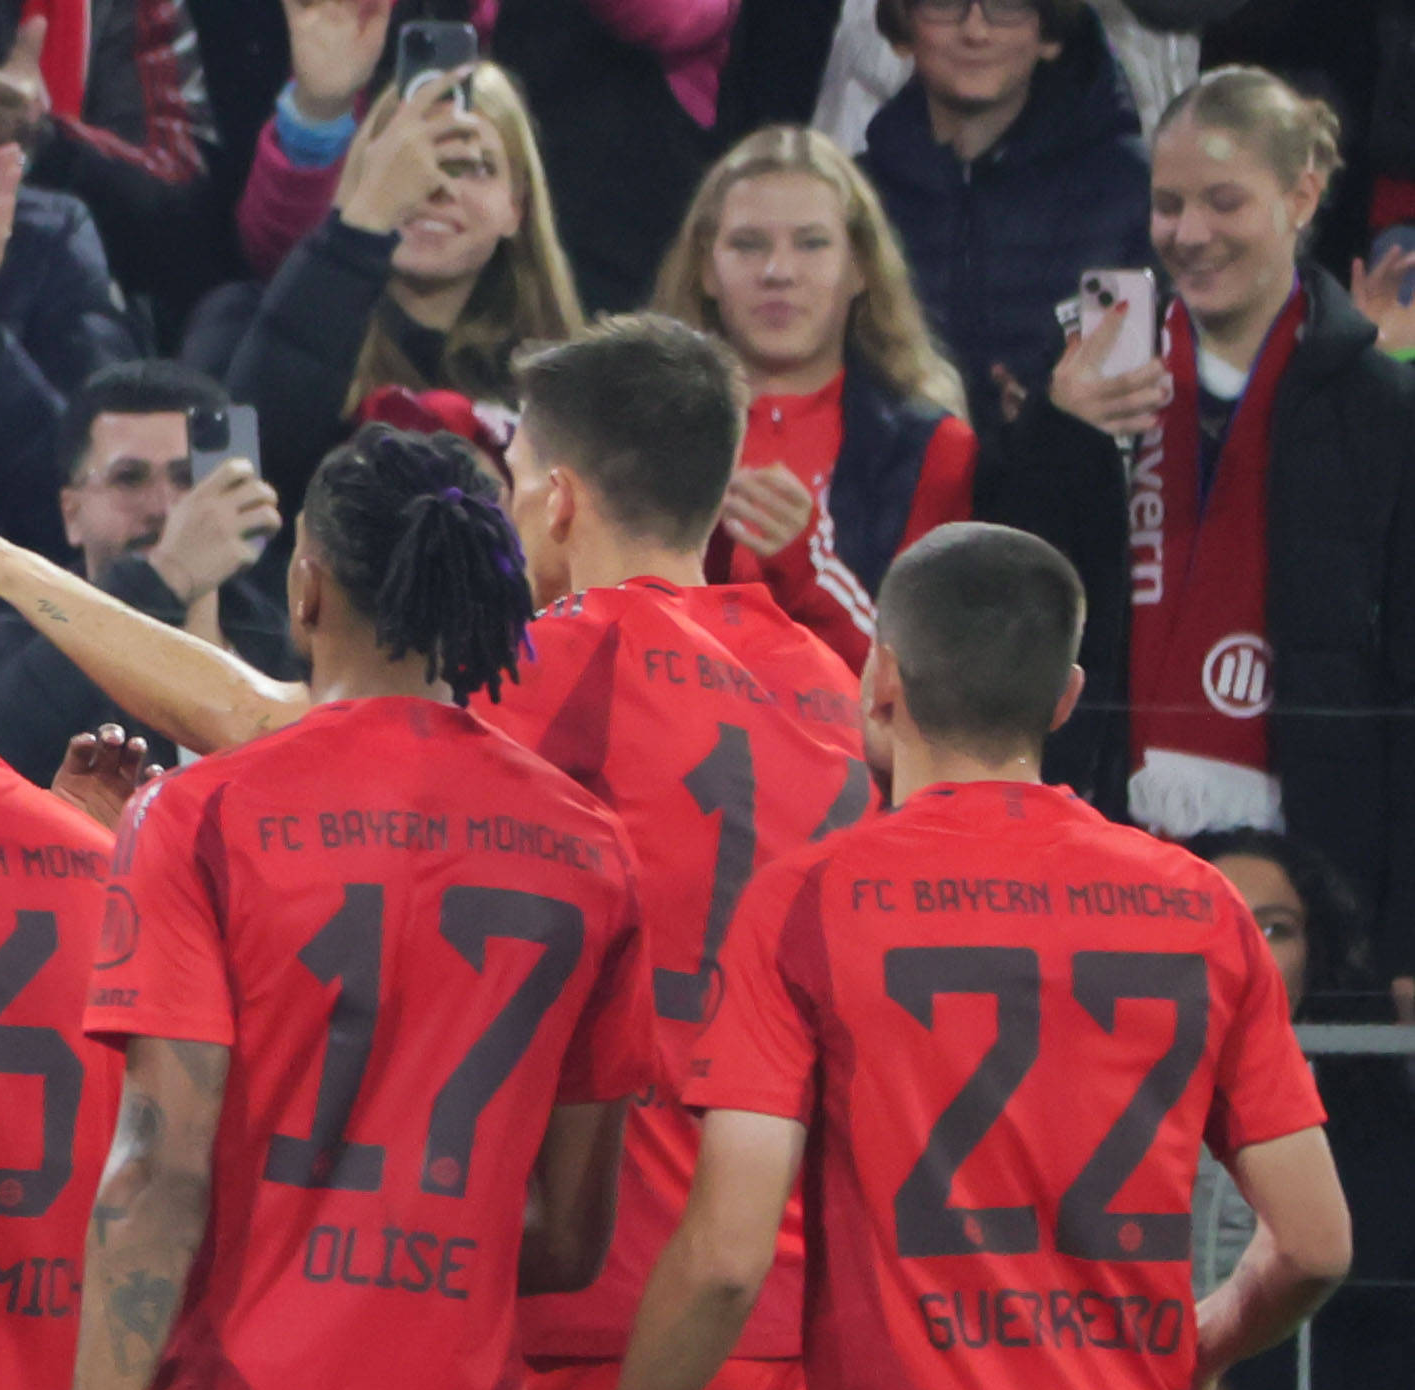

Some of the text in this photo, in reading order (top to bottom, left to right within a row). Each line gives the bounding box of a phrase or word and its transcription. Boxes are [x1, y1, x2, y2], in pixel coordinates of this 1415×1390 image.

[645, 650, 686, 684] FC
[258, 815, 304, 850] FC
[319, 810, 448, 850] BAYERN
[852, 879, 896, 912] FC
[912, 879, 1053, 914] BAYERN
[262, 883, 586, 1198] 17
[882, 946, 1210, 1262] 22
[303, 1225, 479, 1300] OLISE
